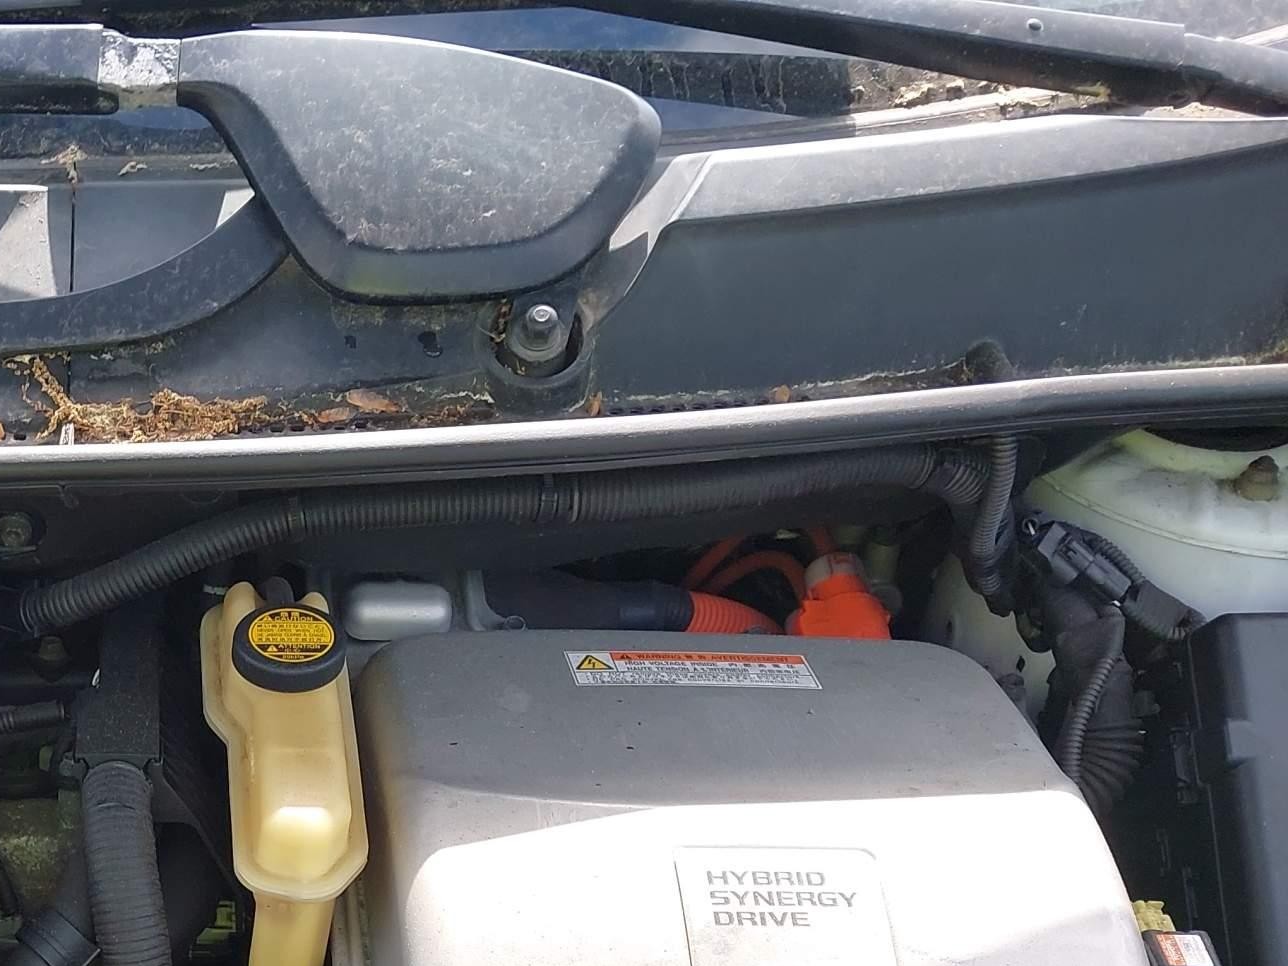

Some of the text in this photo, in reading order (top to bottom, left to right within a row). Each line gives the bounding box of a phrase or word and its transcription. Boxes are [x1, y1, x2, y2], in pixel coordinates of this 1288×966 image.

[706, 870, 826, 886] HYBRID
[710, 890, 857, 907] SYNERGY
[713, 911, 810, 927] DRIVE
